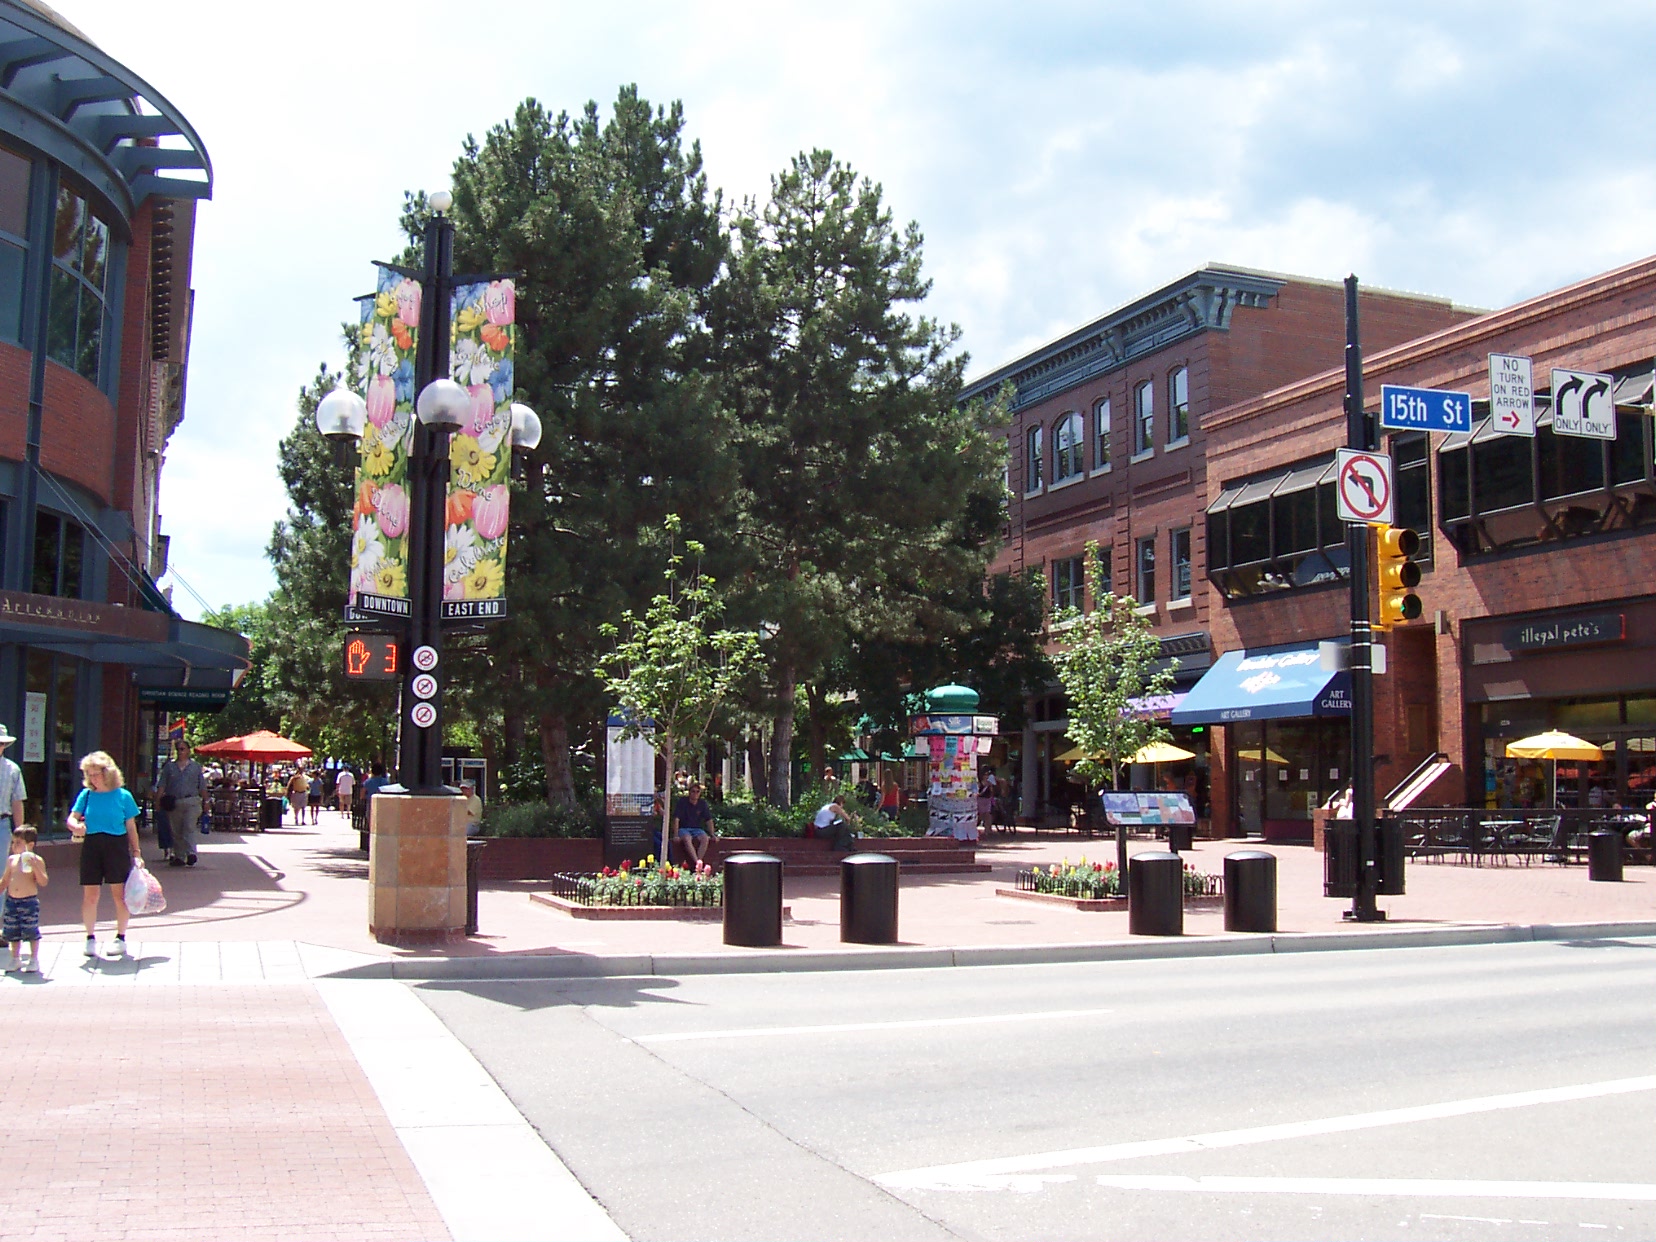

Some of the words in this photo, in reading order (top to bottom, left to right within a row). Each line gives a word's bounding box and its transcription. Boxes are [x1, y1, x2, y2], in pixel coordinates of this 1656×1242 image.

[1503, 358, 1519, 372] NO
[1499, 372, 1524, 384] TURN
[1494, 384, 1507, 395] ON
[1511, 385, 1530, 397] RED
[1389, 393, 1428, 422] 15th
[1442, 398, 1464, 425] St
[1496, 397, 1530, 409] ARROW
[474, 412, 509, 435] Enjoy
[1555, 417, 1580, 431] ONLY
[1585, 421, 1609, 434] ONLY
[449, 536, 505, 583] Celebrate
[363, 595, 409, 614] DOWNTOWN
[448, 602, 474, 616] EAST
[478, 601, 499, 615] END
[1521, 624, 1559, 646] illegal
[1563, 622, 1600, 642] pete's
[384, 644, 397, 673] 3
[1329, 690, 1344, 699] ART
[1321, 699, 1352, 709] GALLERY
[1220, 710, 1230, 719] ART
[1231, 709, 1251, 719] GALLERY
